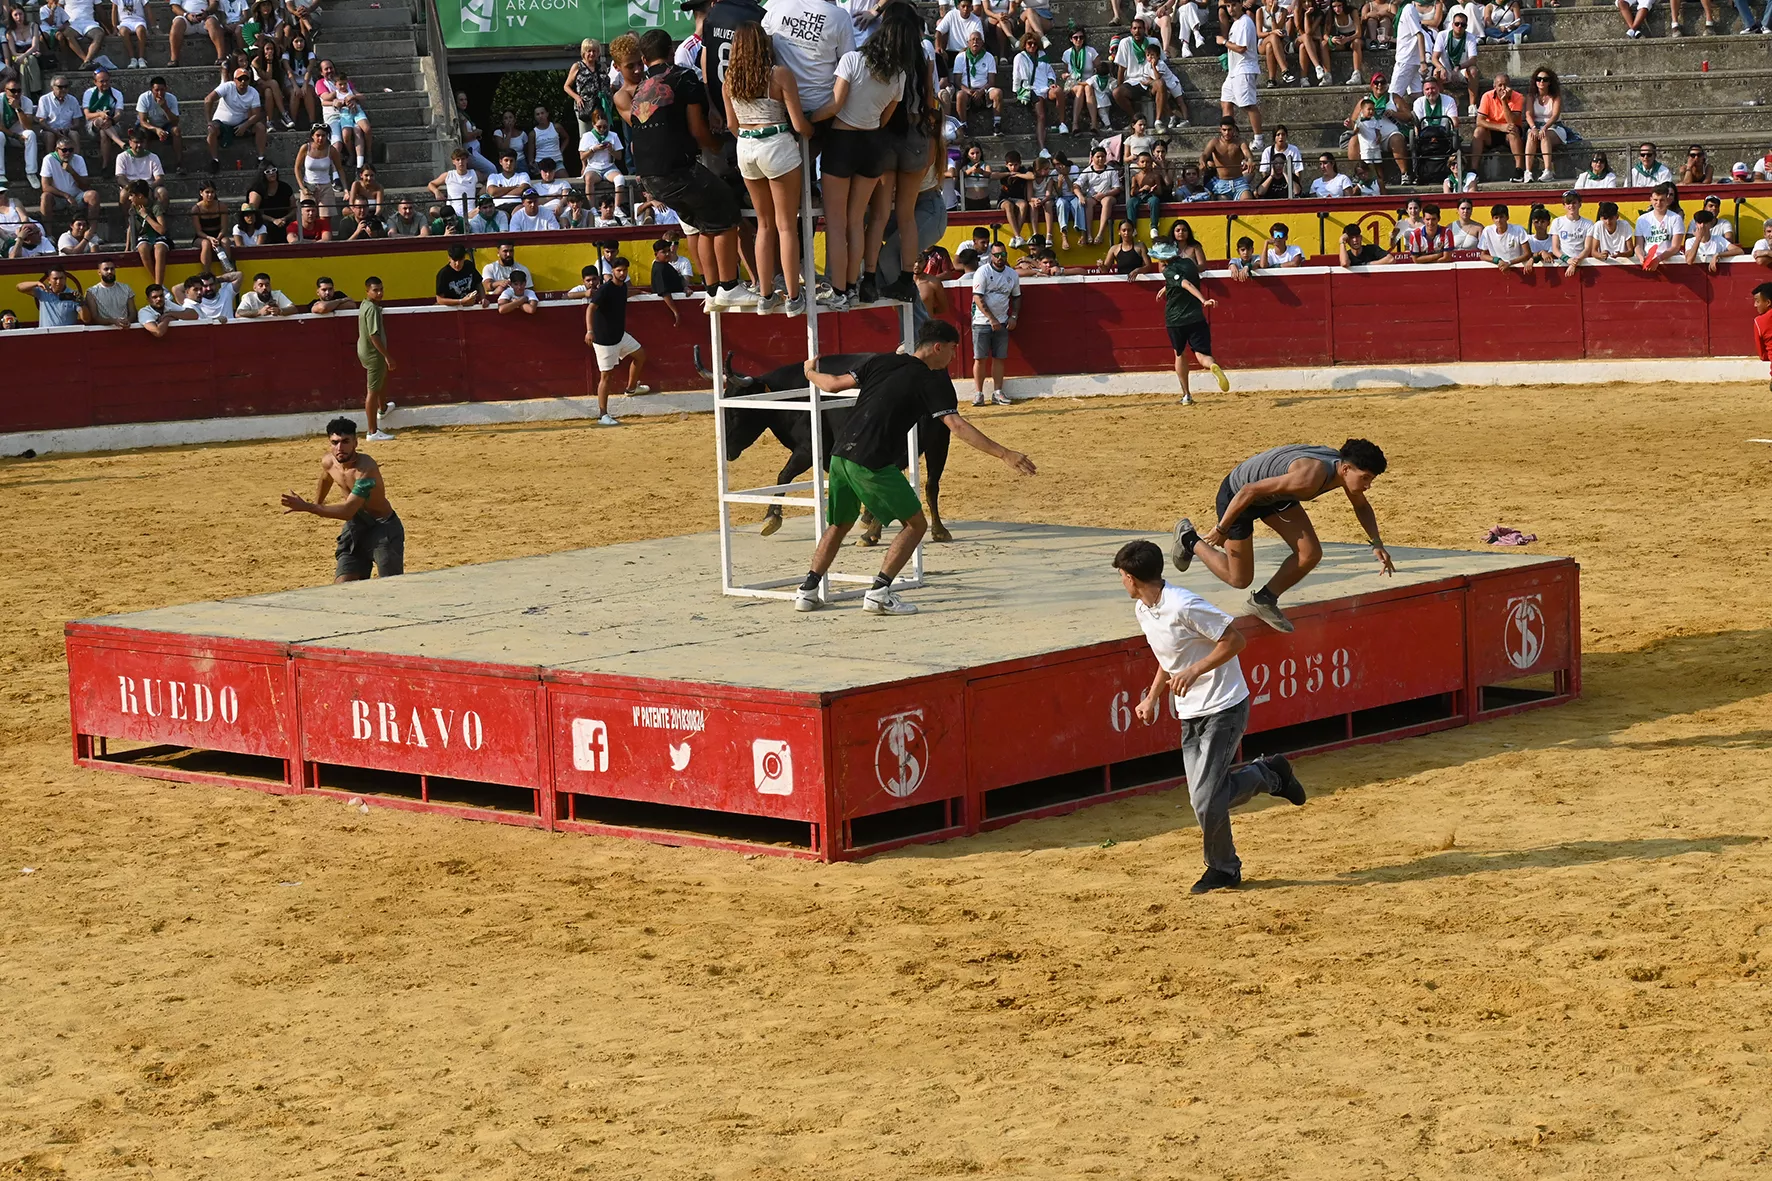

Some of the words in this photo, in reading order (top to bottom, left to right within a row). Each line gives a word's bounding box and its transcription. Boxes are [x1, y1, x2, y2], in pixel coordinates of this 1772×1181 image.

[505, 15, 528, 27] TV
[672, 9, 694, 21] TV
[781, 15, 824, 33] NORTH
[803, 11, 827, 25] THE
[790, 28, 821, 42] FACE
[1366, 220, 1380, 246] 1
[118, 675, 239, 724] RUEDO
[351, 699, 483, 751] BRAVO
[641, 706, 671, 729] PATENTE
